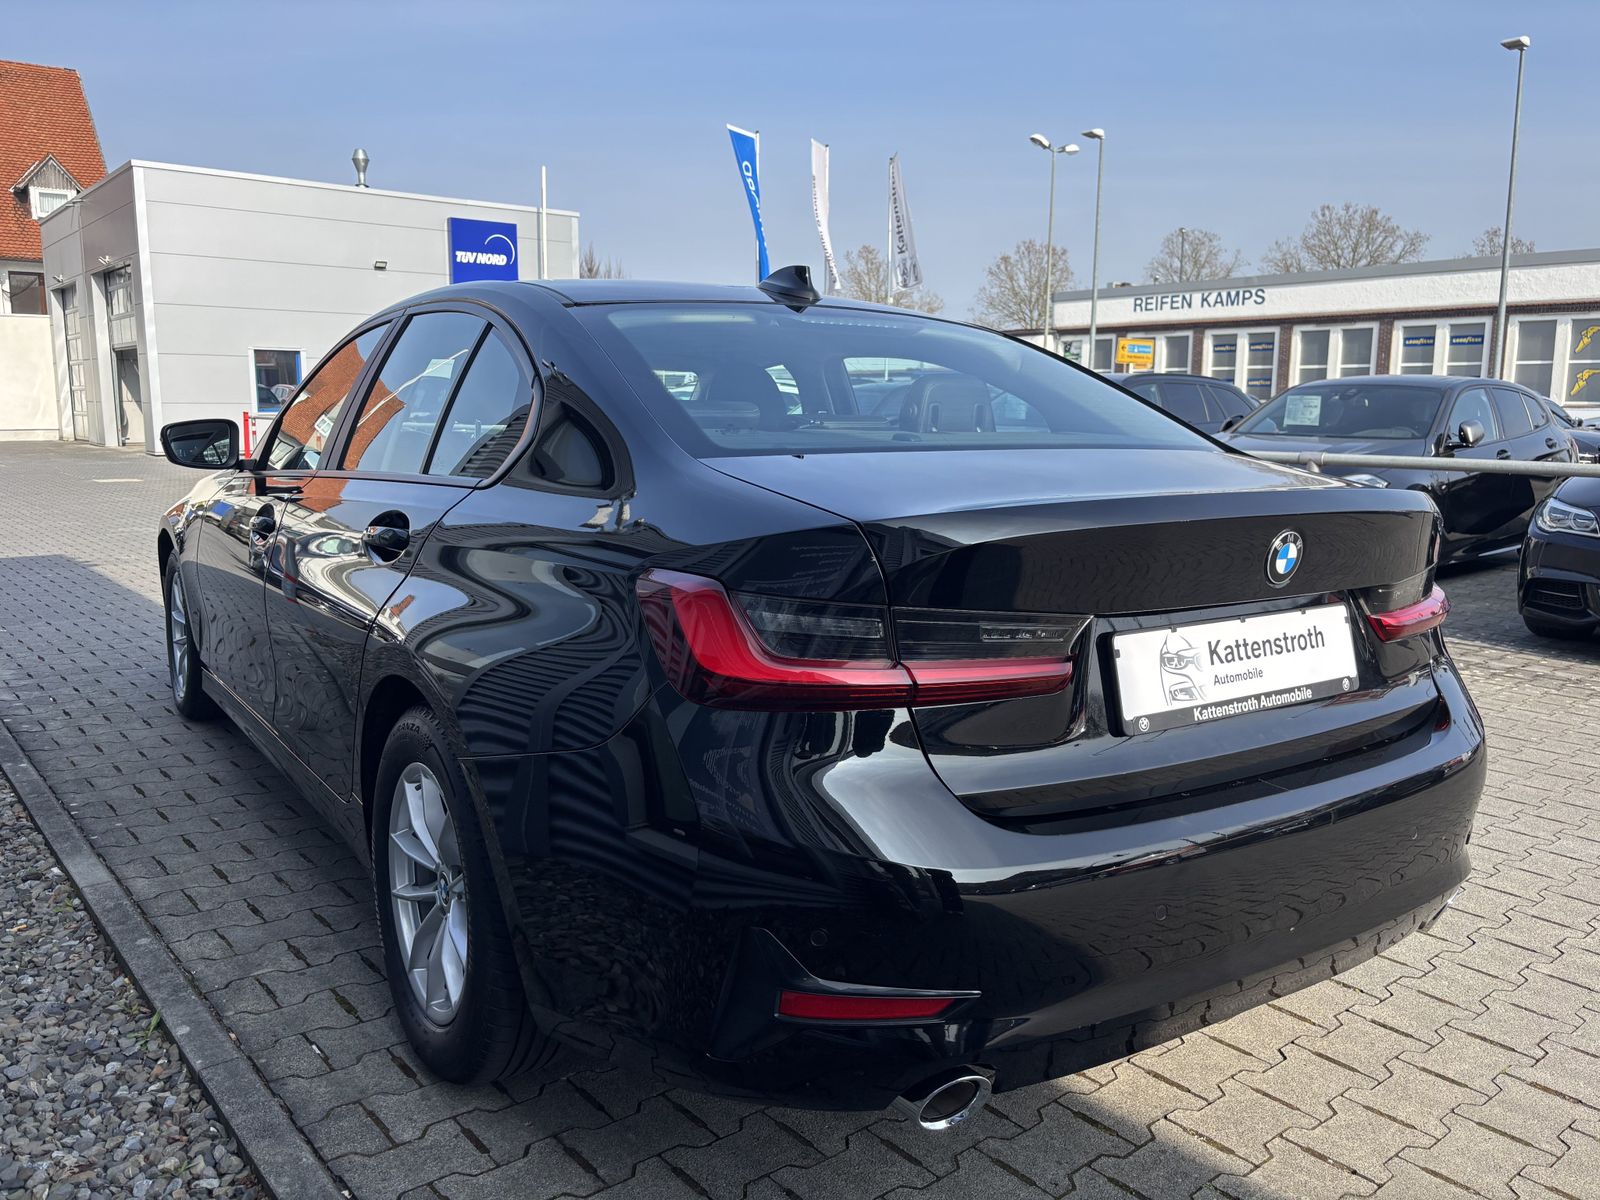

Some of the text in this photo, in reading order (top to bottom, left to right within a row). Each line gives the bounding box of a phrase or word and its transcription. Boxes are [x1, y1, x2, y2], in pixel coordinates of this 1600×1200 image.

[476, 252, 508, 266] NORD
[1133, 288, 1266, 312] REIFEN KAMPS
[1208, 625, 1326, 666] Kattenstroth
[1213, 667, 1264, 687] Automobile
[1193, 688, 1313, 721] Kattenstroth Automobile
